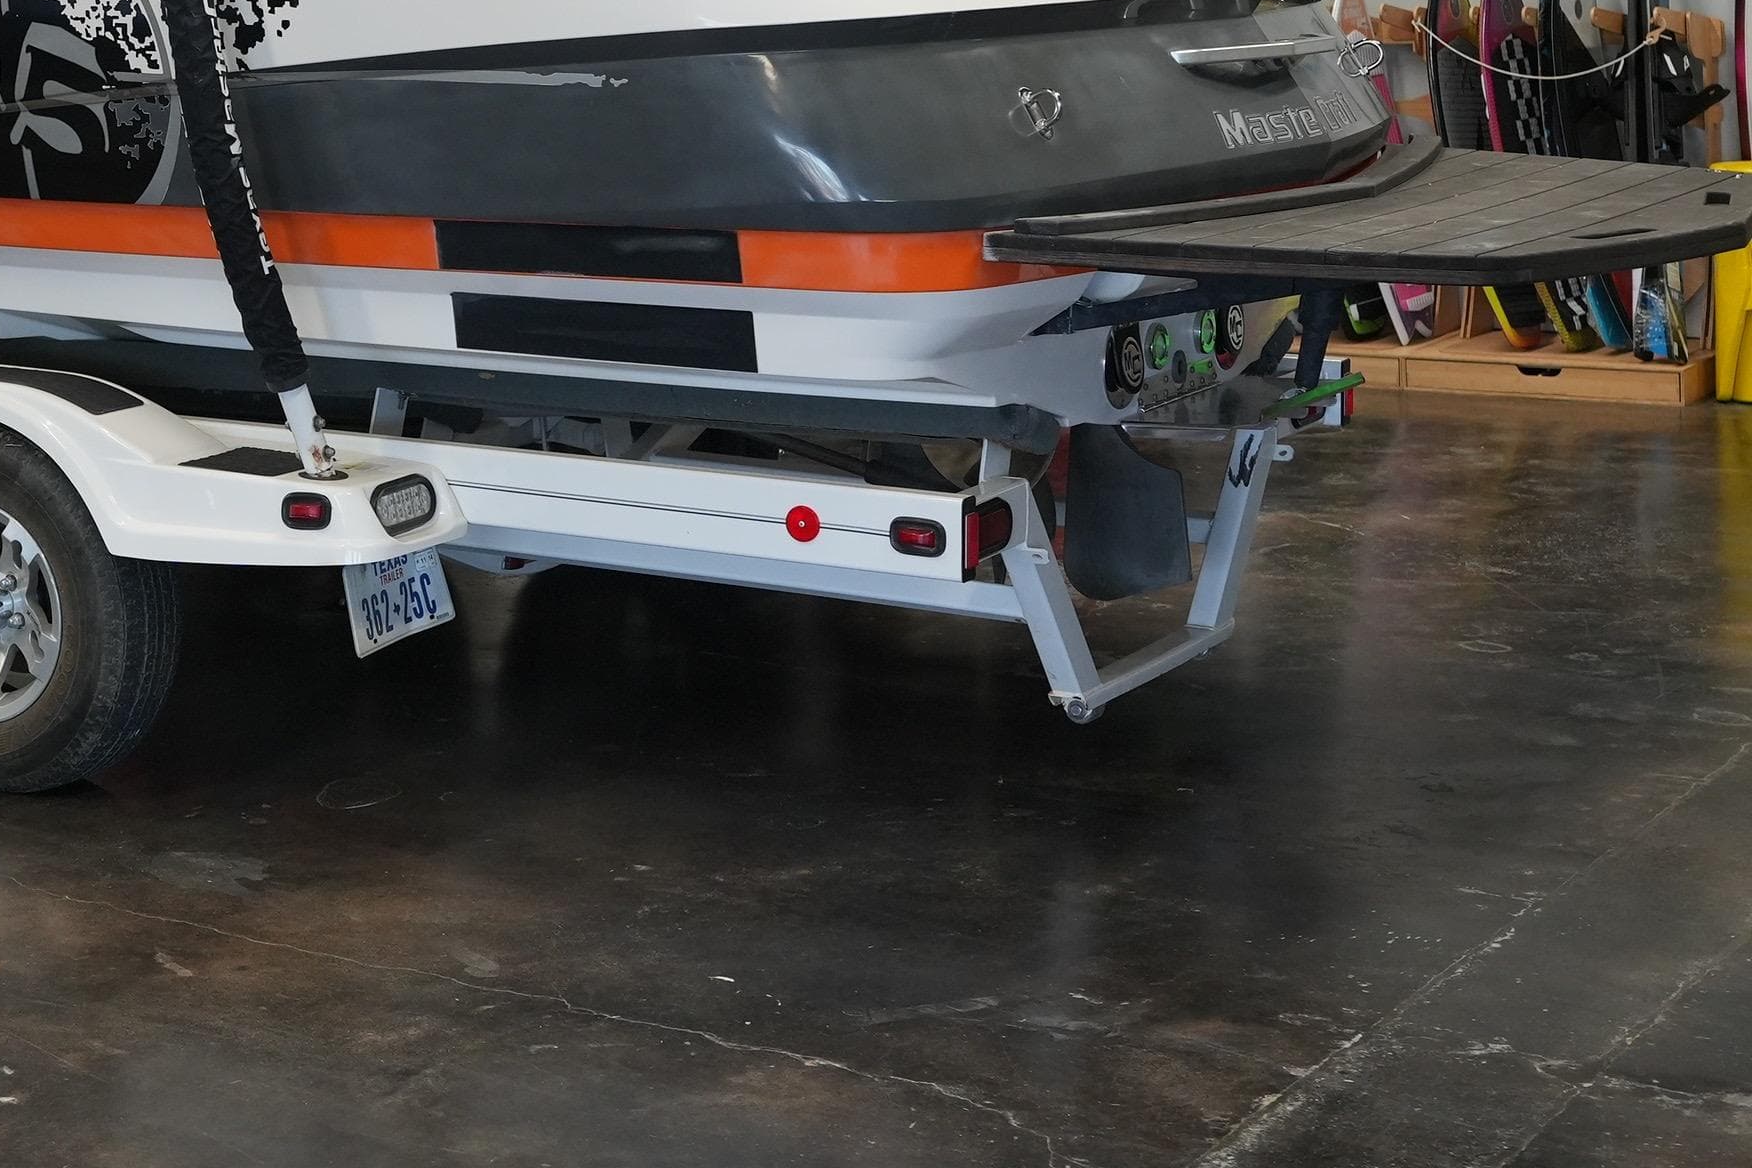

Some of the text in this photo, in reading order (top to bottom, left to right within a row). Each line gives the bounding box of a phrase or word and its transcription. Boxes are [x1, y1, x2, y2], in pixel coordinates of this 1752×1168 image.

[1213, 91, 1358, 149] MasteCraft
[371, 554, 408, 576] TEXAS
[379, 567, 404, 586] TRAILER
[361, 573, 437, 641] 362 25C
